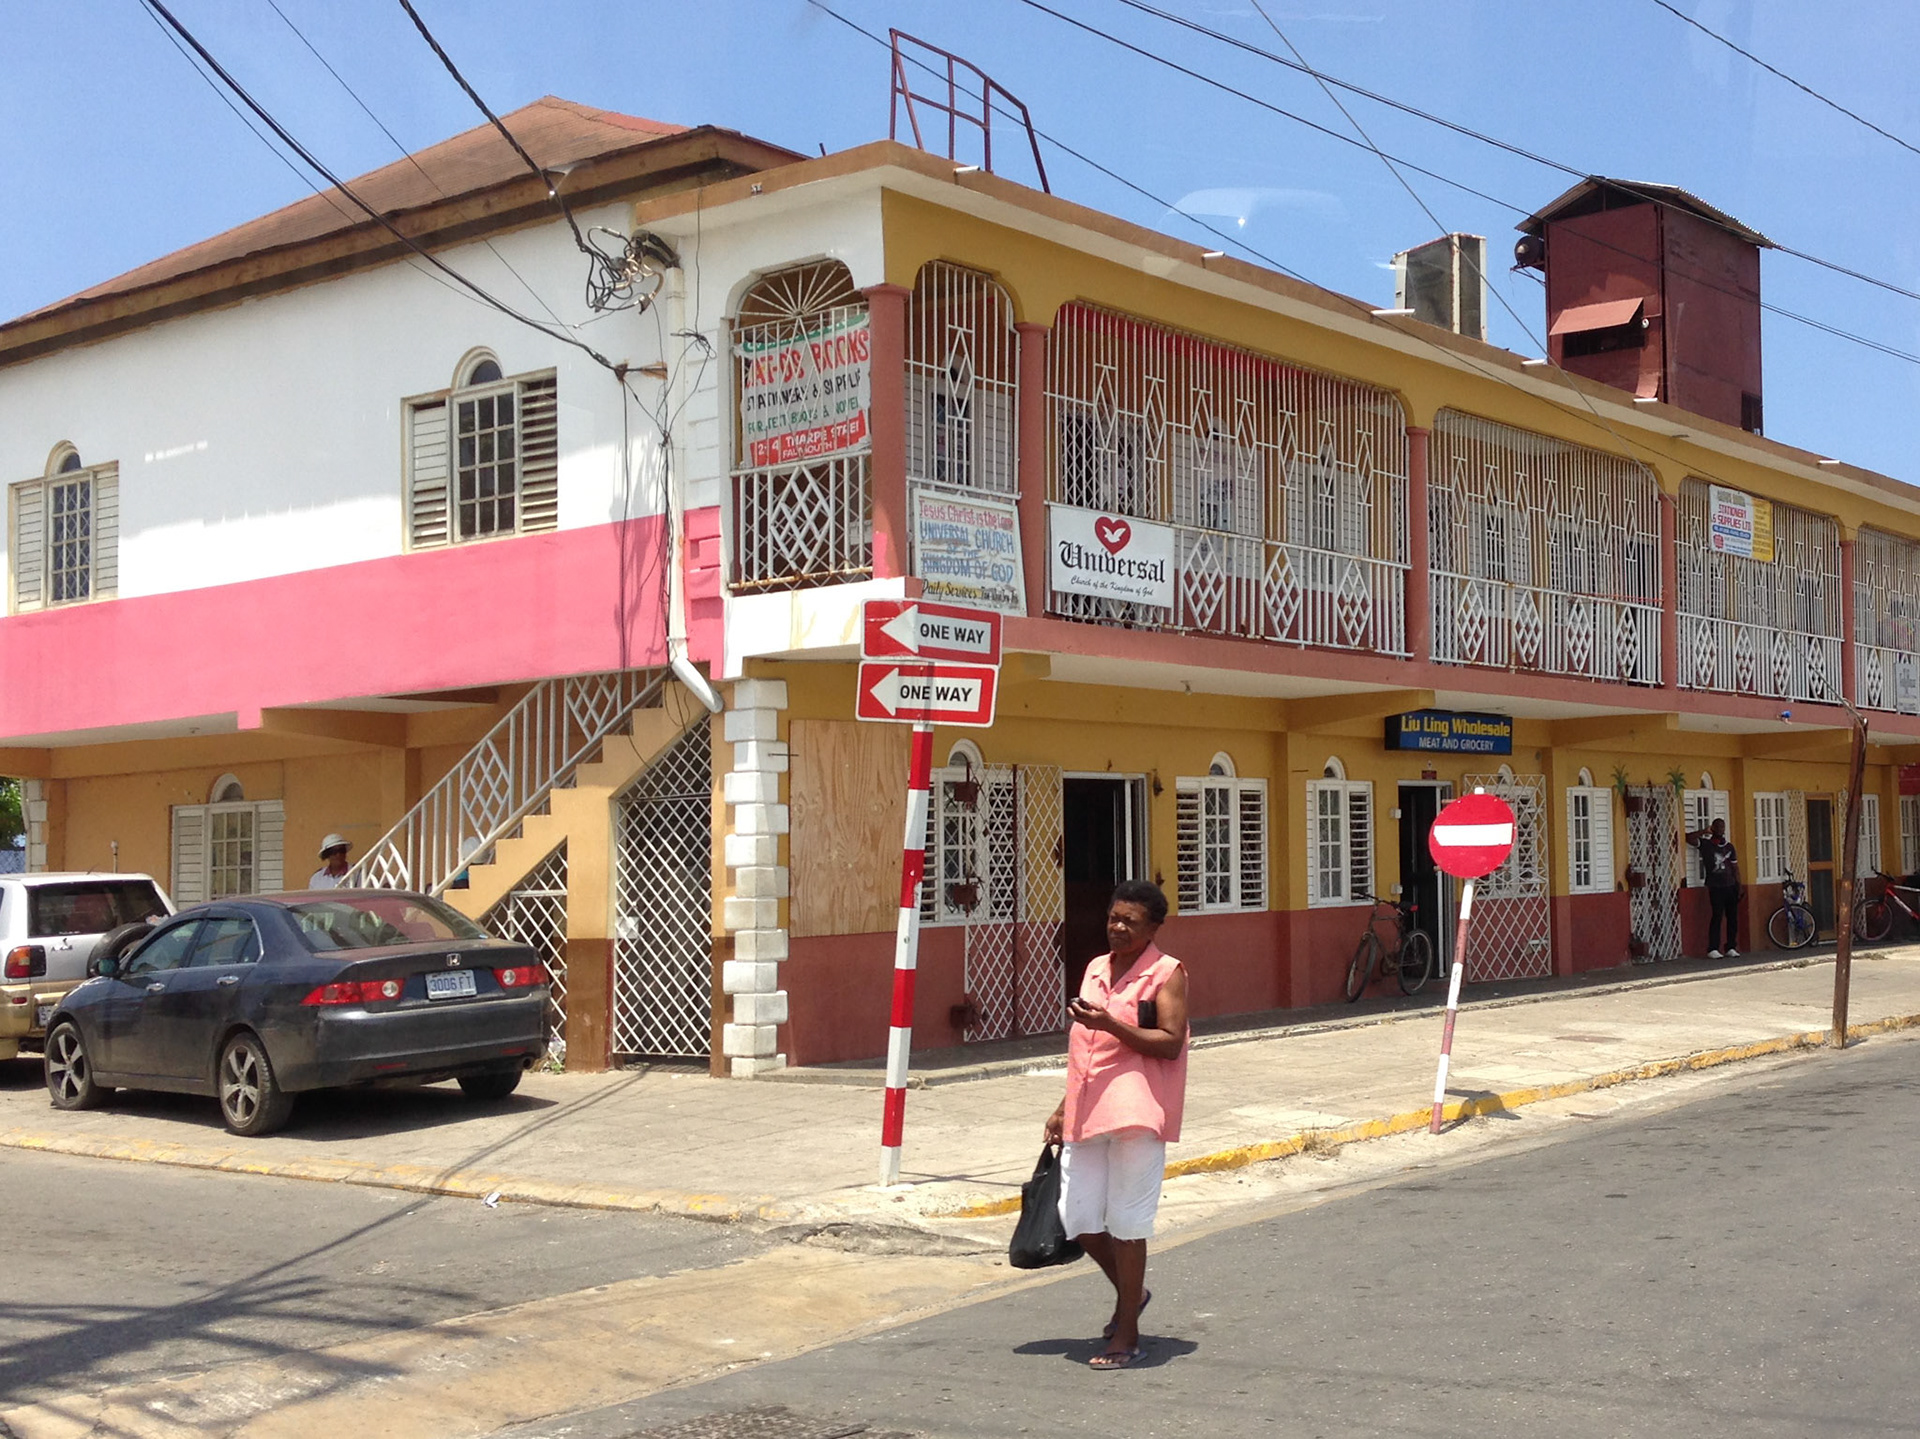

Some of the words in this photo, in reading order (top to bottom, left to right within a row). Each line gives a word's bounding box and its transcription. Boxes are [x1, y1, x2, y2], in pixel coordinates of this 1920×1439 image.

[811, 328, 869, 374] BOOKS
[785, 429, 827, 448] THARPE
[919, 500, 946, 520] Jesus
[1718, 503, 1747, 519] STATIONERY
[1718, 514, 1742, 529] SUPPLIES
[920, 520, 969, 543] UNIVERSAL
[975, 528, 1014, 554] CHURCH
[974, 560, 988, 580] OF
[991, 562, 1014, 583] GOD
[1059, 540, 1166, 583] Universal
[922, 578, 944, 600] Daily
[945, 581, 977, 599] Services
[1070, 574, 1092, 586] Church
[1093, 580, 1099, 590] of
[1100, 580, 1108, 589] the
[1110, 581, 1134, 594] Kingdom
[1135, 586, 1141, 596] of
[1142, 587, 1154, 597] God
[920, 623, 950, 640] ONE
[954, 626, 985, 644] WAY
[900, 684, 931, 700] ONE
[936, 686, 973, 702] WAY
[1401, 715, 1420, 732] Liu
[1423, 716, 1449, 737] Ling
[1452, 718, 1511, 737] Wholesale
[1418, 737, 1440, 749] MEAT
[1442, 738, 1459, 750] AND
[1460, 738, 1496, 751] GROCERY
[430, 977, 457, 992] 3006
